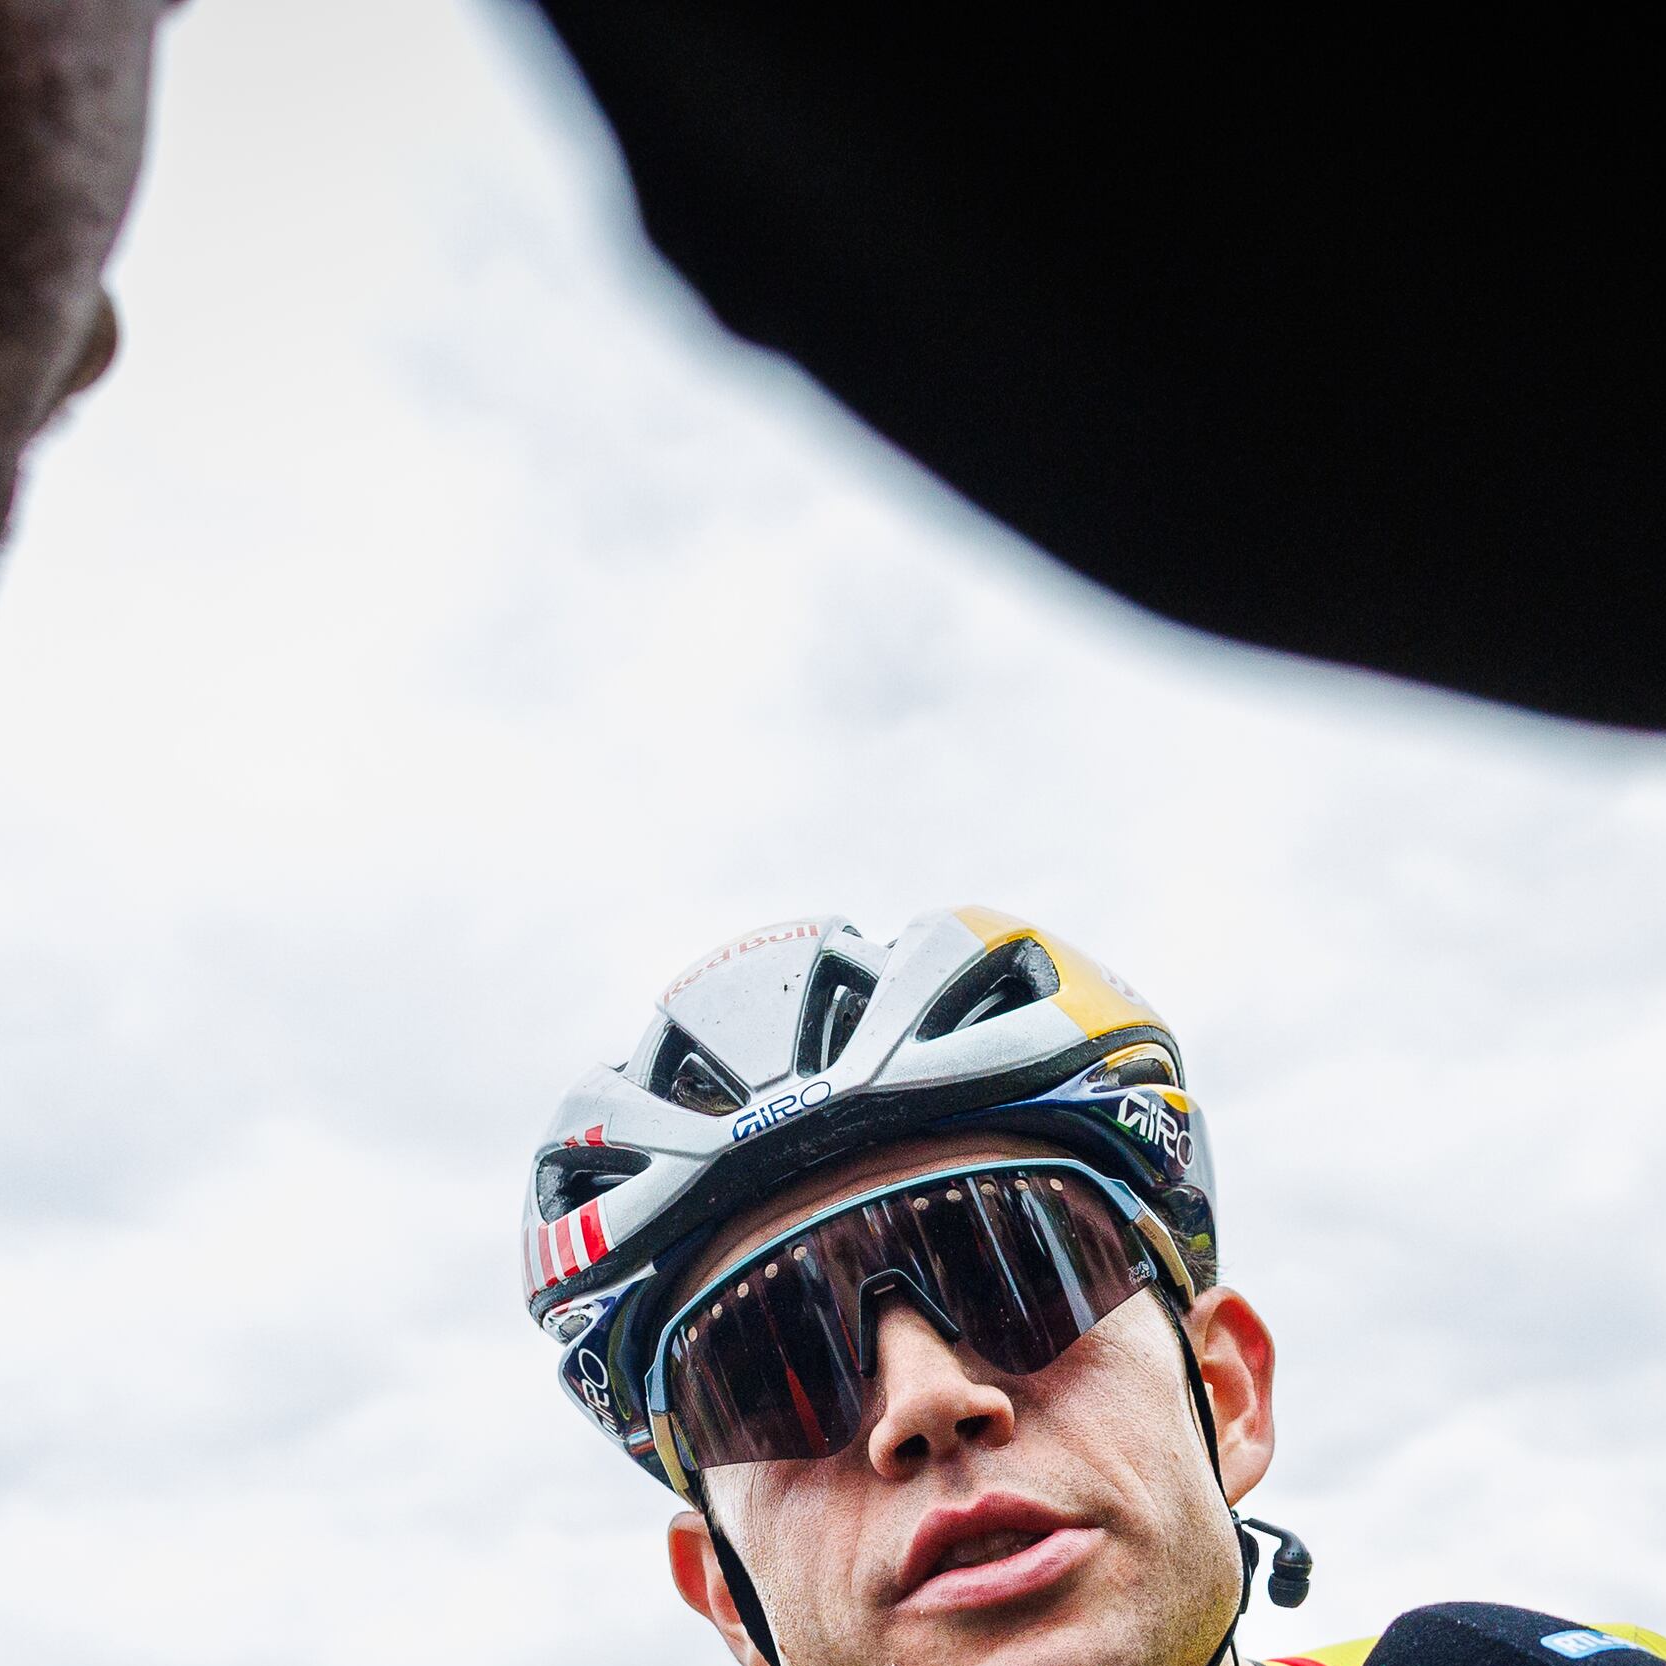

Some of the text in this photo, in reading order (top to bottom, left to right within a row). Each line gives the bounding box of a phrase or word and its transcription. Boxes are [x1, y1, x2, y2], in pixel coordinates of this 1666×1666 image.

[739, 924, 819, 953] Bull
[732, 1081, 831, 1141] GIRO
[1117, 1092, 1194, 1169] GIRO
